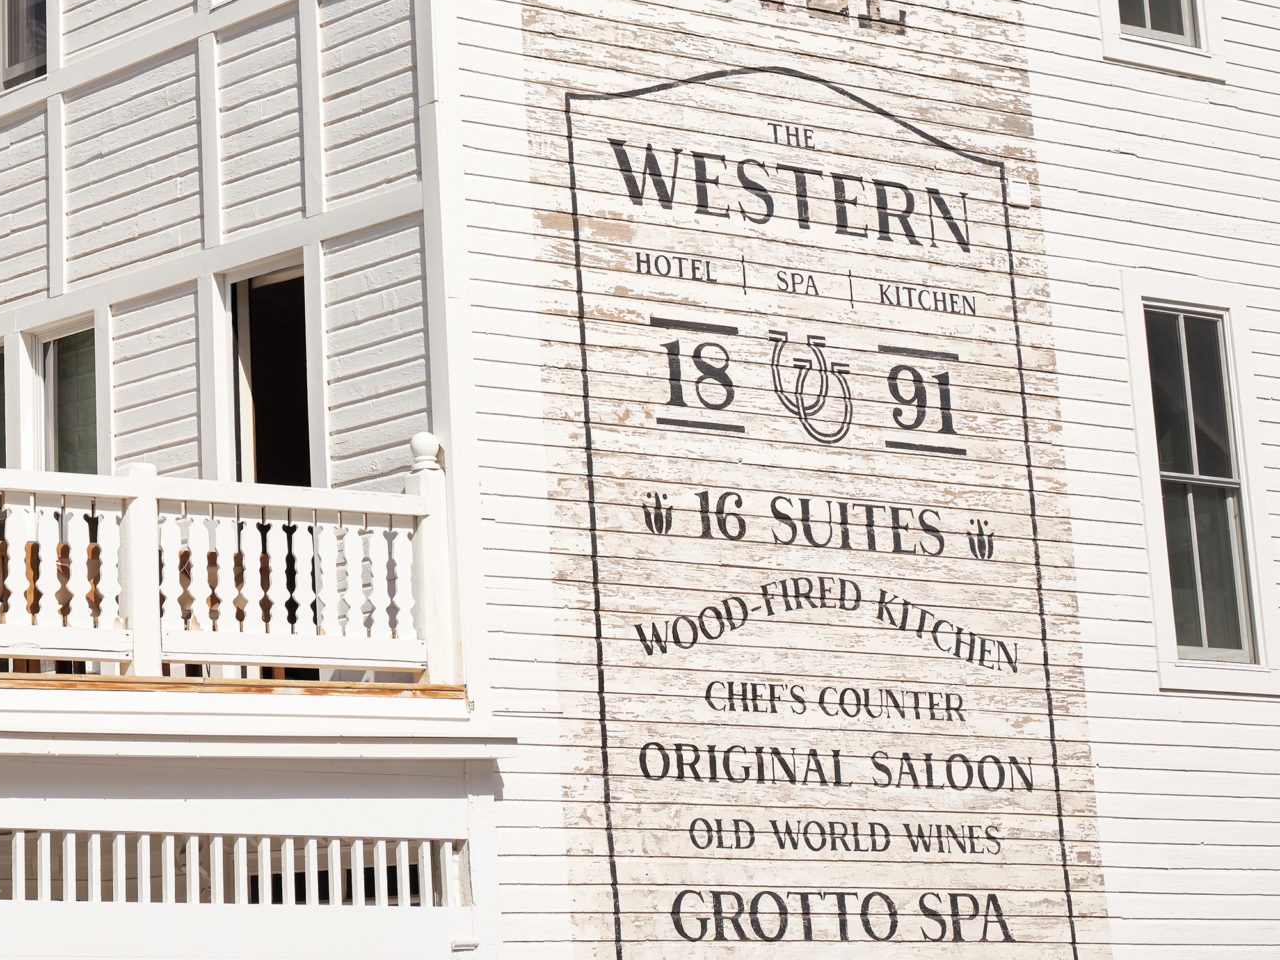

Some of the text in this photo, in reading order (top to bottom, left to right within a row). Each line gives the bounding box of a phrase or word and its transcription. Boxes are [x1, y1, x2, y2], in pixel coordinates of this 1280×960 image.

[767, 122, 815, 150] THE
[607, 137, 971, 253] WESTERN
[635, 252, 977, 317] HOTEL SPA KITCHEN
[660, 339, 958, 435] 18 91
[694, 491, 945, 557] 16 SUITES
[634, 576, 1019, 674] WOOD-FIRED KITCHEN
[704, 680, 967, 723] CHEF'S COUNTER
[639, 741, 1035, 793] ORIGINAL SALOON
[689, 817, 1002, 856] OLD WORLD WINES
[670, 889, 1017, 943] GROTTO SPA
